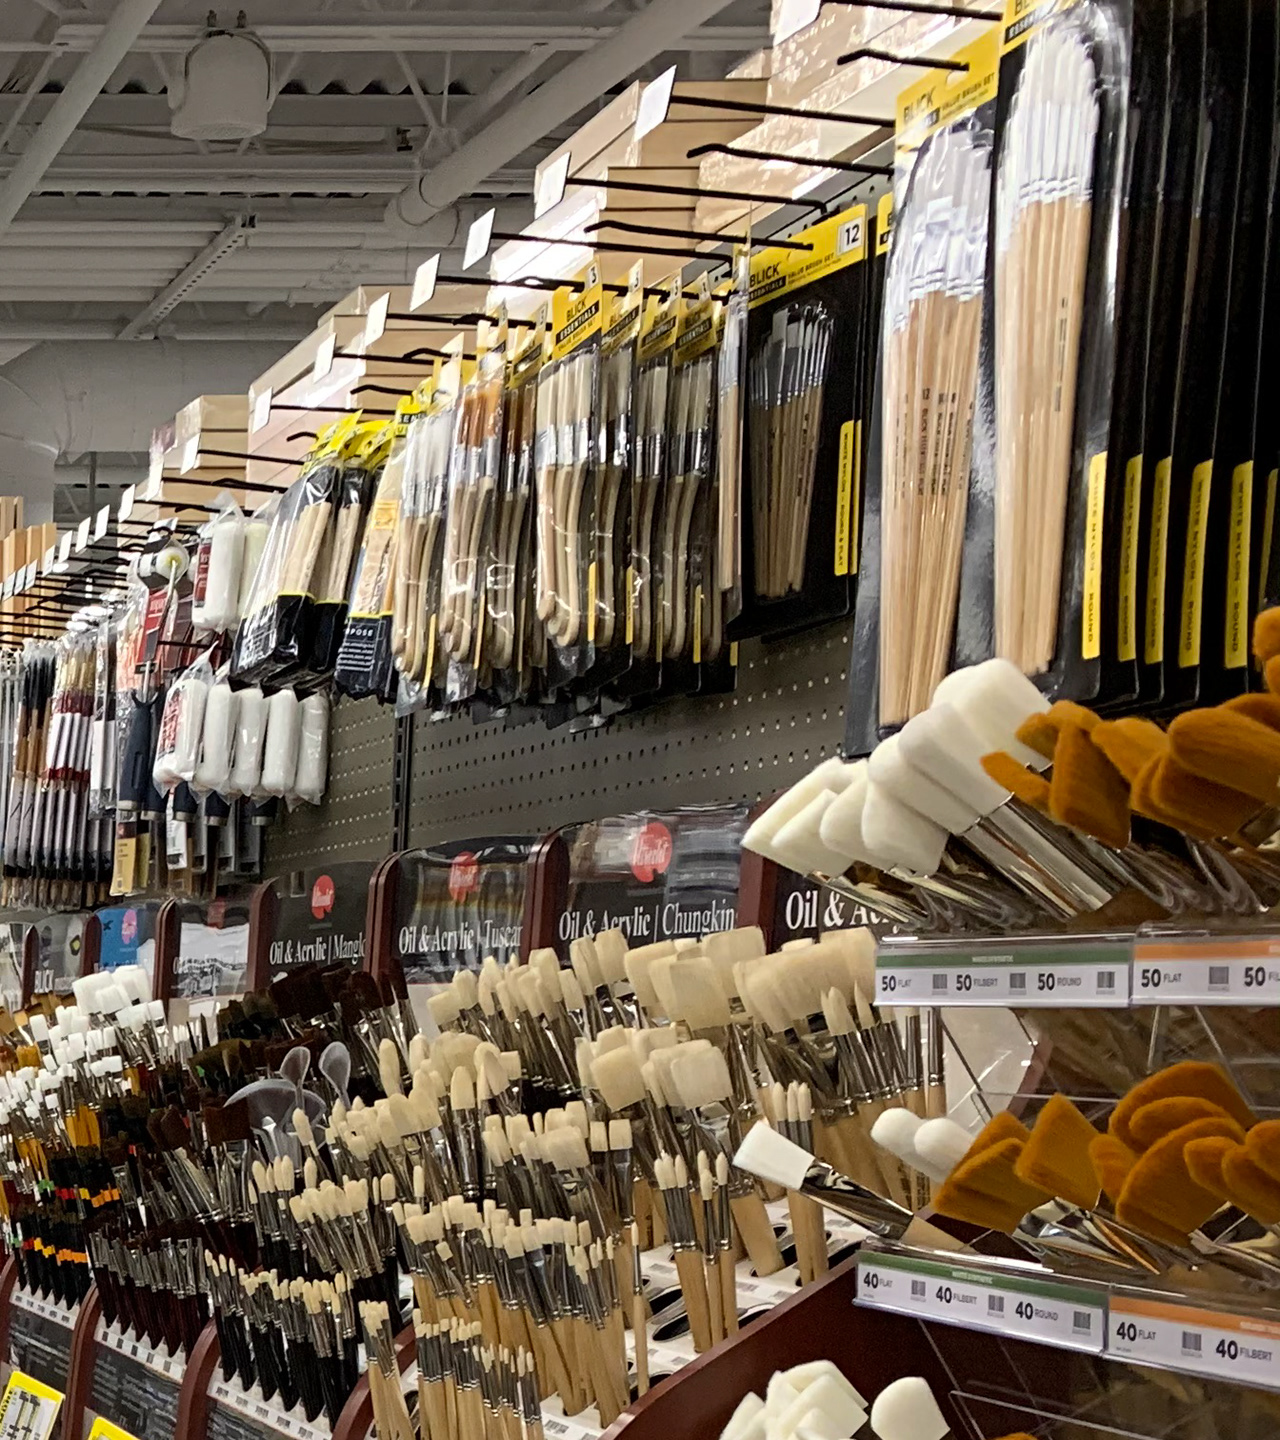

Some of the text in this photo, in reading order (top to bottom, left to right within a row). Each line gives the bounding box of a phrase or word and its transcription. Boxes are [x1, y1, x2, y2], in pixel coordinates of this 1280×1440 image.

[844, 222, 861, 246] 12
[589, 265, 598, 284] 3
[749, 262, 782, 287] BLICK
[559, 304, 598, 341] ESSENTIALS
[566, 298, 587, 321] BLICK
[558, 899, 738, 942] Oil & Acrylic Chungkin
[785, 890, 818, 930] Oil
[823, 890, 846, 927] &
[269, 939, 284, 965] Oil
[294, 935, 327, 963] Acrylic
[398, 924, 416, 954] Oil
[417, 925, 430, 952] &
[431, 920, 475, 959] Acrylic
[881, 972, 1082, 992] 50 FLAT 50 FILBERT 50 ROUND
[1141, 967, 1161, 988] 50
[1163, 972, 1182, 983] FLAT
[1244, 965, 1266, 987] 50
[863, 1272, 1059, 1322] 40 FLAT 40 FILBERT 40 ROUND
[1116, 1321, 1273, 1362] 40 FLAT 40 FILBERT
